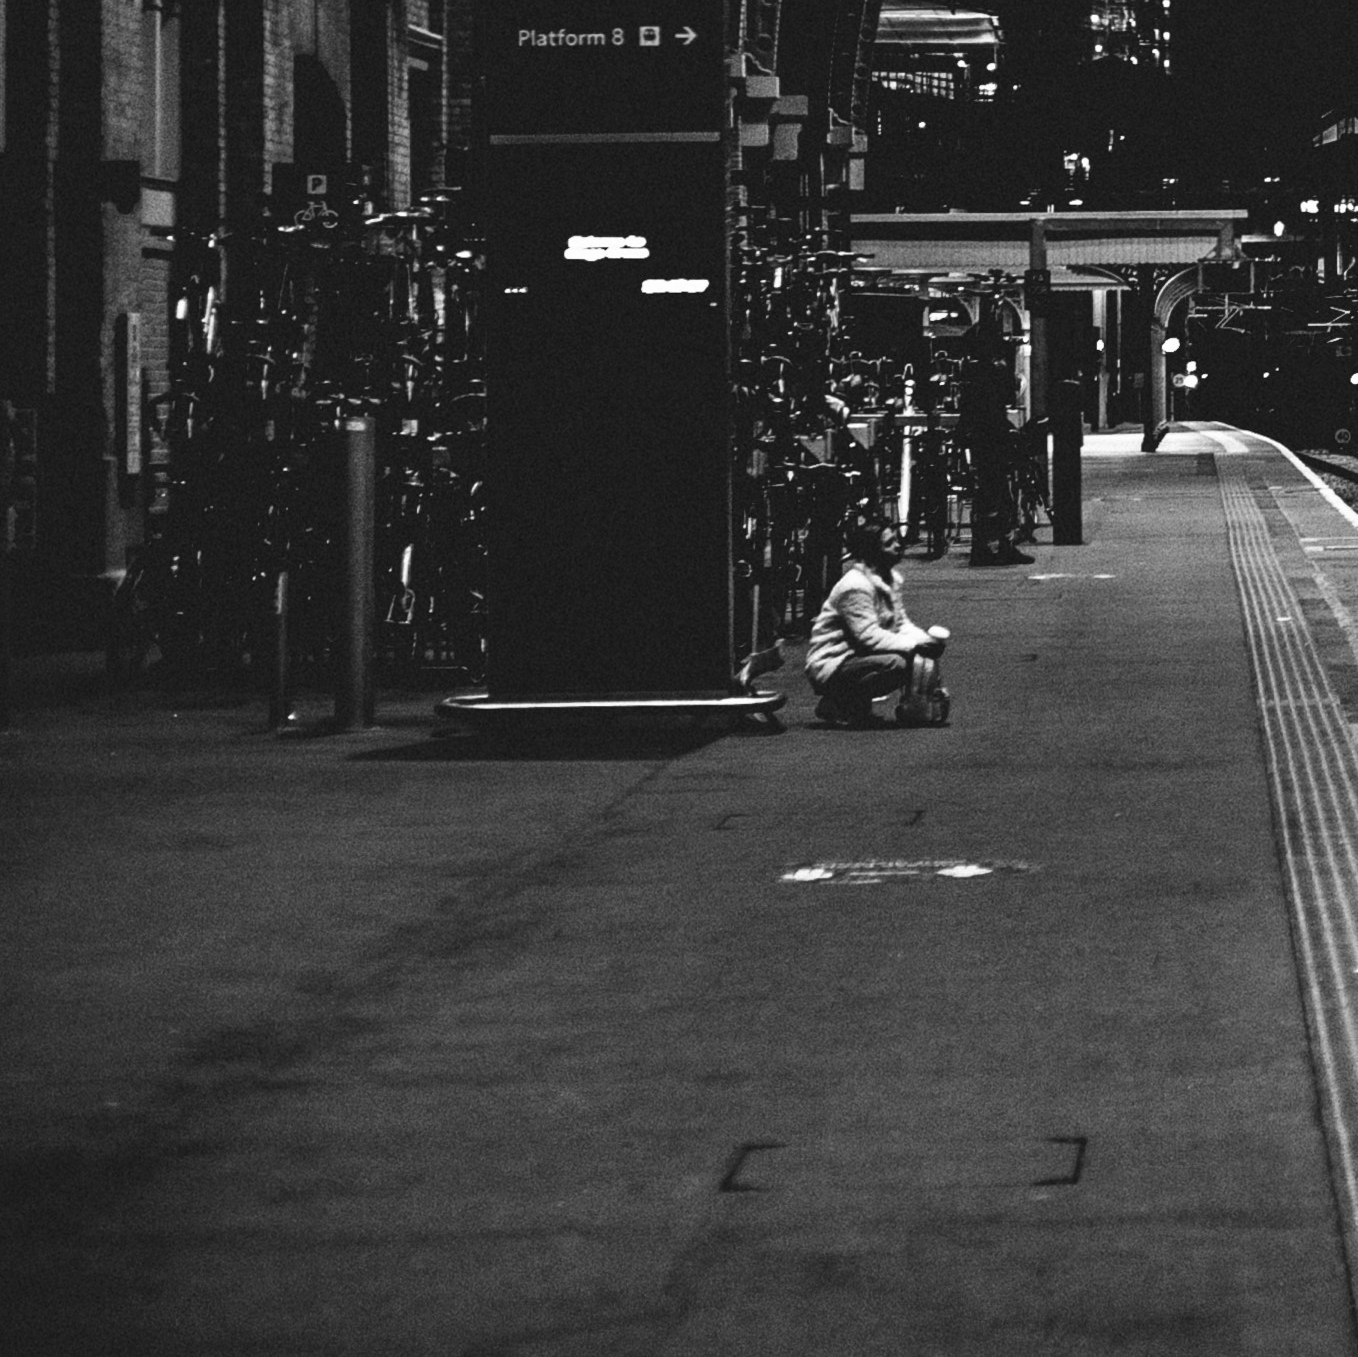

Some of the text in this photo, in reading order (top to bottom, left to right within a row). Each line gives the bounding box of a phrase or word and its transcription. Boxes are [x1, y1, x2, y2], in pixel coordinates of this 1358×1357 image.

[518, 27, 625, 47] Platform 8
[311, 177, 324, 192] P
